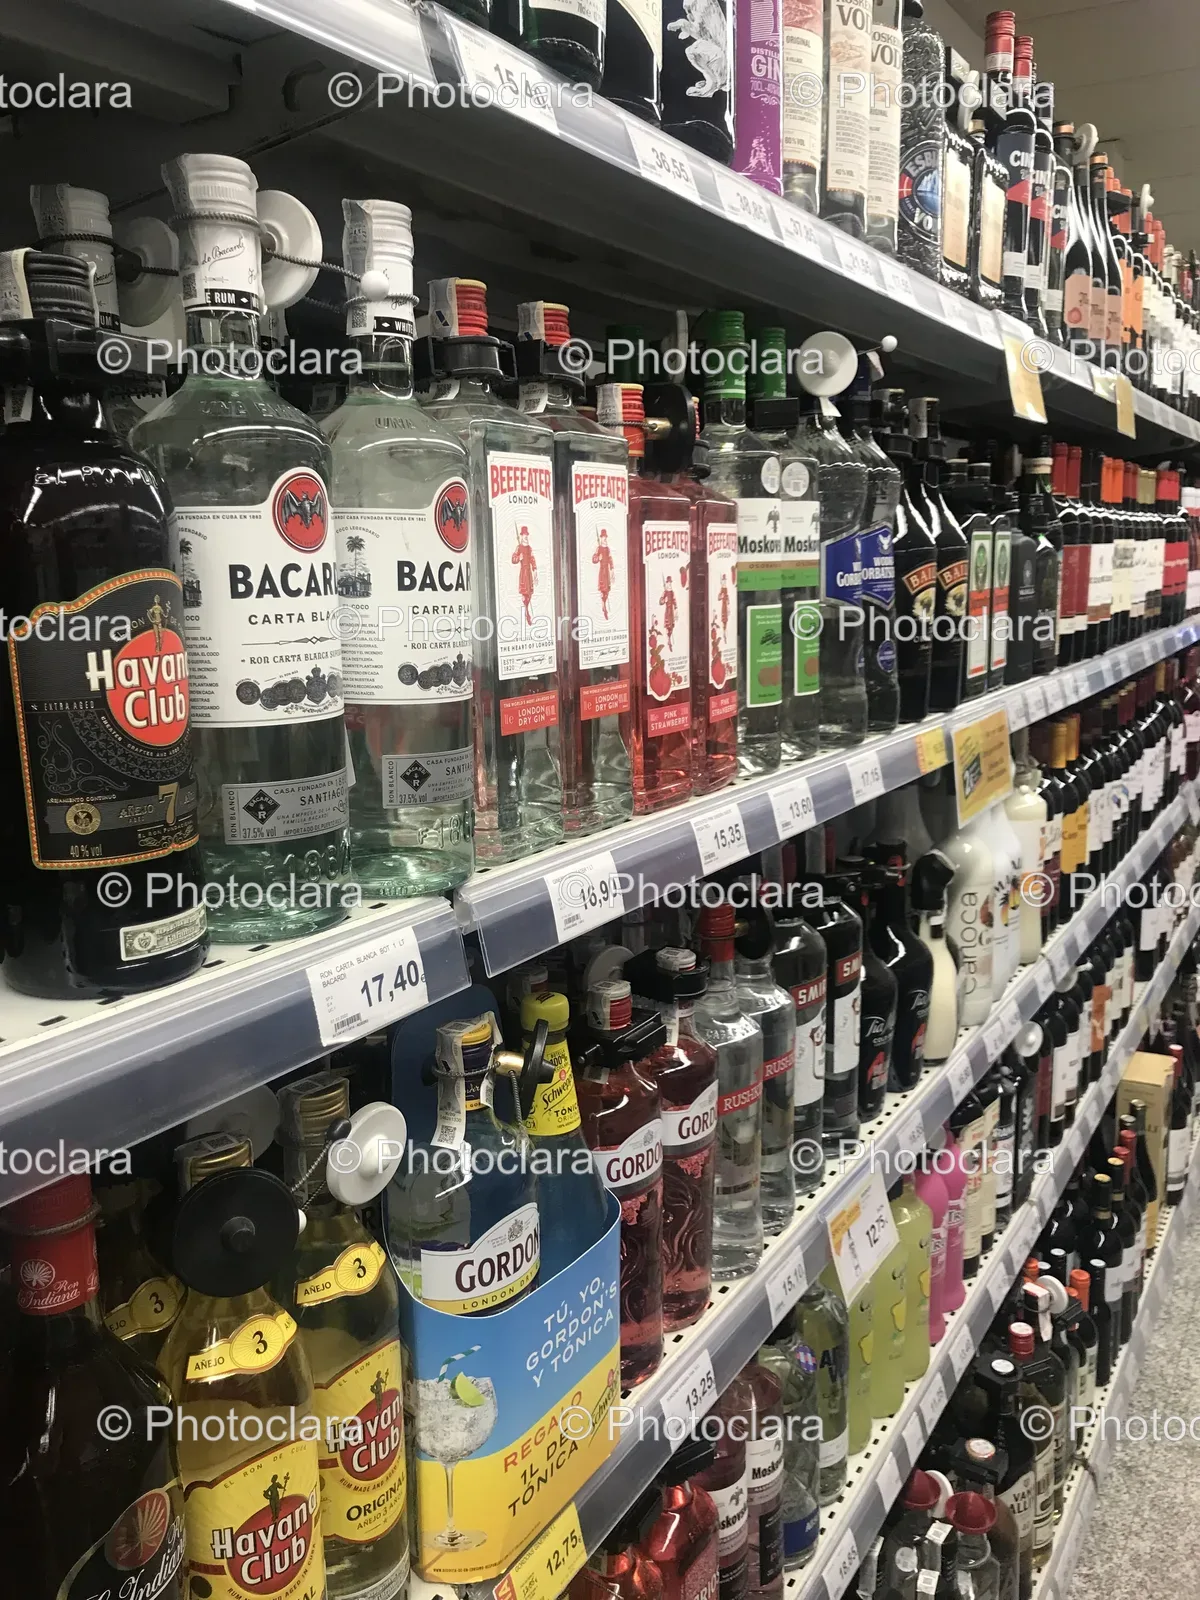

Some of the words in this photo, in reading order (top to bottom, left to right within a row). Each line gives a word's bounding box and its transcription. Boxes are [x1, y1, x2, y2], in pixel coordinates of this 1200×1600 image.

[651, 147, 689, 183] 36,55
[214, 291, 237, 305] RUM
[490, 464, 552, 502] BEEFEATER
[574, 473, 627, 506] BEEFEATER
[508, 494, 539, 505] LONDON
[590, 501, 616, 509] LONDON
[350, 525, 380, 539] LEGENDARIO
[644, 530, 689, 555] BEEFEATER
[708, 531, 737, 556] BEEFEATER
[248, 612, 306, 626] CARTA
[412, 605, 455, 615] CARTA
[411, 642, 427, 650] RON
[536, 641, 554, 649] LONDON
[250, 654, 270, 665] RON
[273, 653, 301, 663] CARTA
[304, 651, 328, 662] BLANCA
[44, 702, 70, 711] EXTRA
[73, 700, 95, 710] AGED
[124, 684, 187, 730] Club
[595, 693, 619, 704] LONDON
[595, 703, 607, 712] DRY
[608, 700, 618, 709] GIN
[518, 705, 546, 717] LONDON
[518, 717, 532, 727] DRY
[533, 714, 546, 723] GIN
[663, 709, 677, 719] PINK
[650, 716, 689, 731] STRAWBERRY
[860, 767, 880, 787] 17,15
[297, 784, 327, 792] FUNDADA
[300, 786, 345, 806] SANTIAGO
[118, 804, 154, 819] AÑEJO
[158, 782, 179, 825] 7
[228, 790, 237, 822] BLANCO
[399, 794, 418, 804] 37.5%
[788, 796, 812, 820] 13,60
[291, 810, 317, 818] EMPRESA
[230, 826, 238, 838] RON
[242, 827, 265, 839] 37.5%
[266, 826, 277, 837] vol
[283, 826, 313, 836] IMPORTADO
[713, 823, 742, 850] 15,35
[70, 845, 80, 858] 40
[81, 844, 89, 857] %
[319, 969, 334, 980] RON
[335, 961, 355, 973] CARTA
[356, 951, 378, 965] BLANCA
[379, 945, 391, 956] BOT
[398, 938, 405, 947] LT
[321, 973, 347, 988] BACARDI
[360, 959, 420, 1008] 17,40
[53, 1280, 79, 1293] Ron
[303, 1280, 332, 1297] AÑEJO
[353, 1257, 367, 1279] 3
[25, 1287, 81, 1309] Indiana
[461, 1281, 516, 1310] LONDON
[519, 1271, 535, 1288] DRY
[150, 1292, 165, 1314] 3
[543, 1299, 573, 1333] TÚ,
[579, 1276, 605, 1304] YO,
[525, 1280, 618, 1372] GORDON'S
[193, 1356, 225, 1372] AÑEJO
[252, 1329, 268, 1355] 3
[532, 1368, 544, 1388] Y
[551, 1309, 614, 1373] TÓNICA
[354, 1361, 371, 1375] RON
[685, 1370, 714, 1412] 13,25
[352, 1424, 400, 1473] Club
[546, 1428, 569, 1461] DE
[224, 1479, 235, 1489] EL
[242, 1463, 263, 1477] RON
[339, 1477, 352, 1491] RUM
[353, 1485, 370, 1493] MADE
[508, 1439, 580, 1518] TÓNICA
[346, 1471, 405, 1522] ORIGINAL
[210, 1483, 319, 1561] Havana
[356, 1512, 381, 1530] AÑEJO
[240, 1535, 307, 1587] Club
[545, 1529, 578, 1577] 12,75
